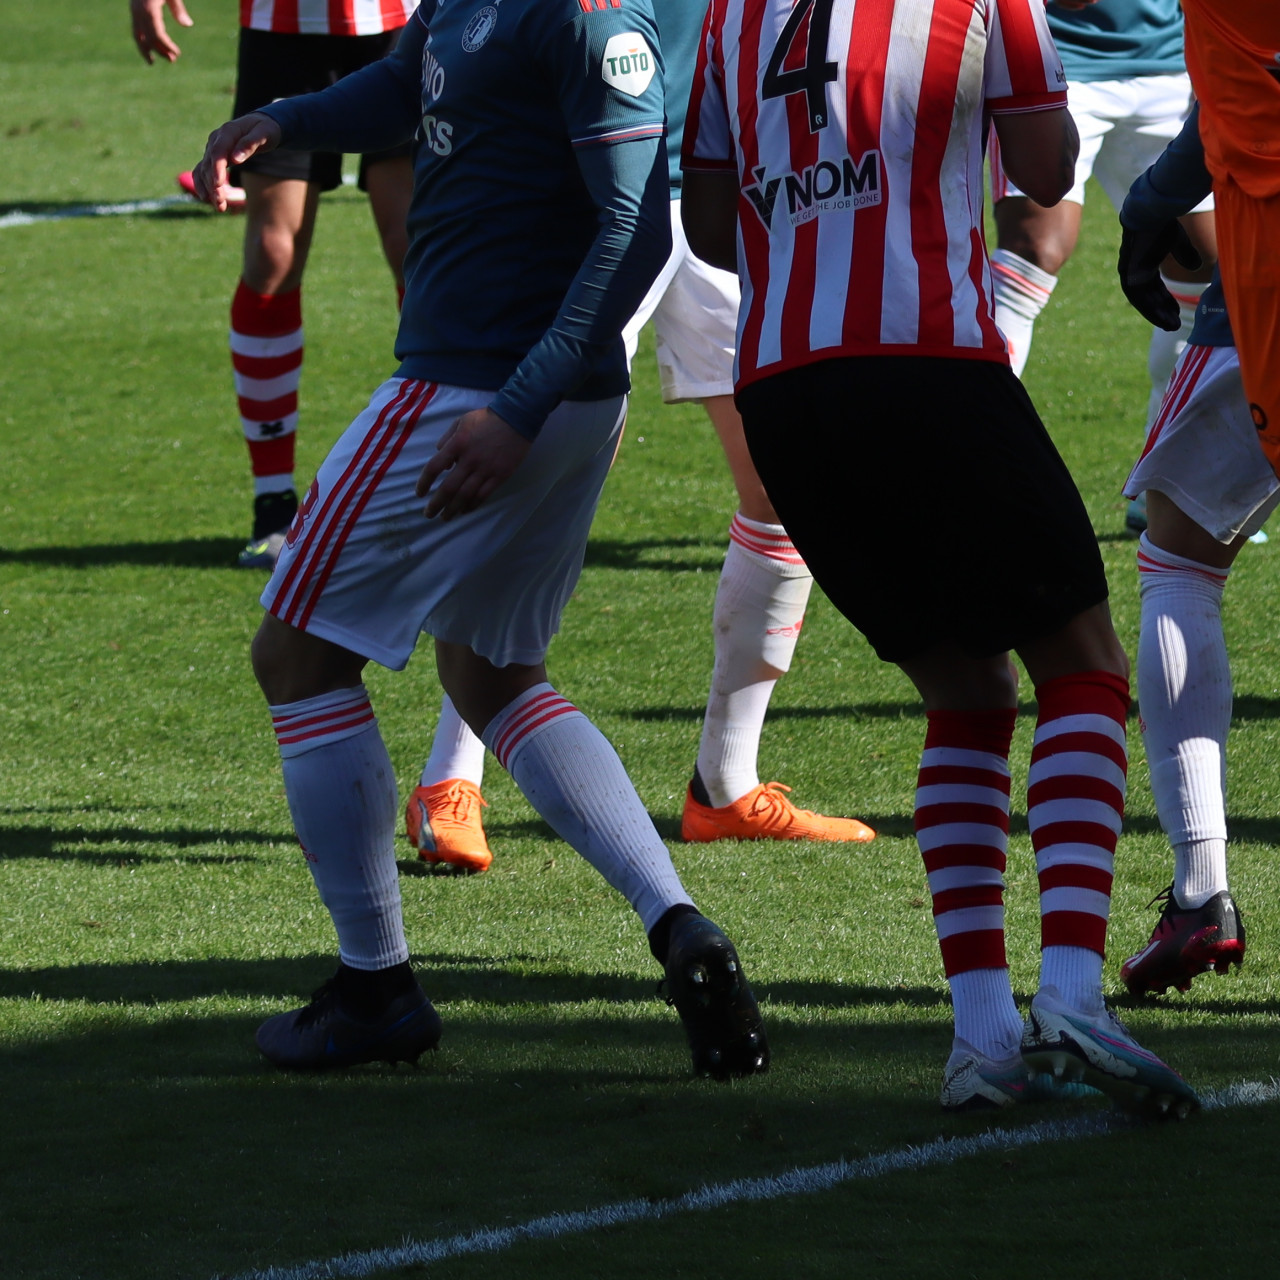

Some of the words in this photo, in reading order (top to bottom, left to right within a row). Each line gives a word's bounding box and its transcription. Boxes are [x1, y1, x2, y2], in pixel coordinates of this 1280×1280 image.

[607, 52, 649, 77] TOTO
[802, 208, 816, 220] GET
[833, 200, 851, 210] JOB
[854, 193, 879, 207] DONE
